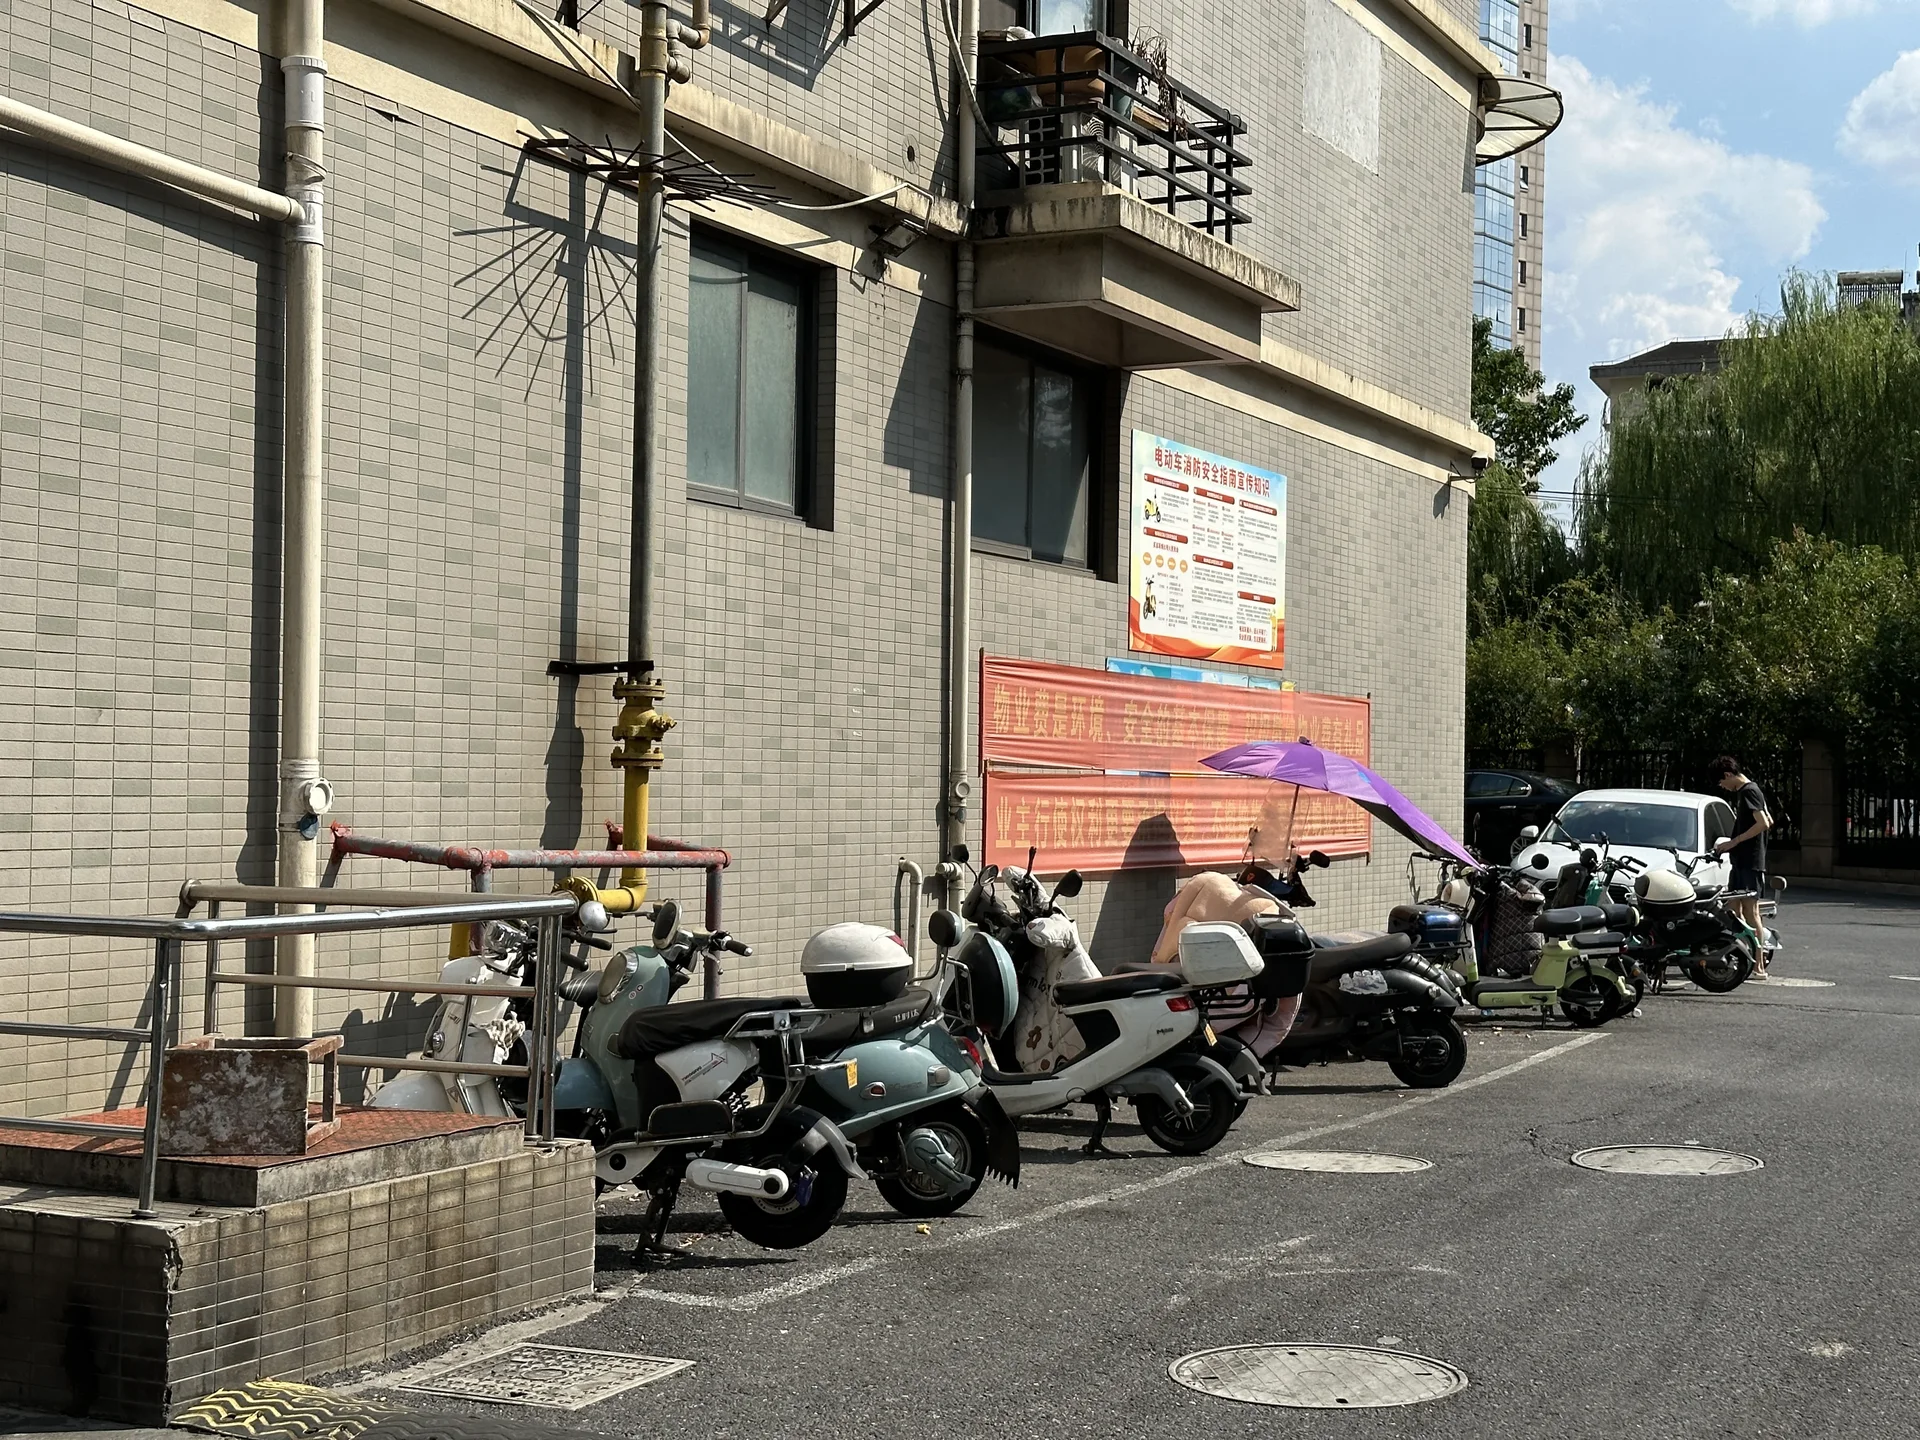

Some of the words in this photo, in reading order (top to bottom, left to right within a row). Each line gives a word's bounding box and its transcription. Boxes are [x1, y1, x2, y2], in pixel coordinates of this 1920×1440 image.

[1154, 446, 1270, 498] 电动车消防安全指南宣传知识
